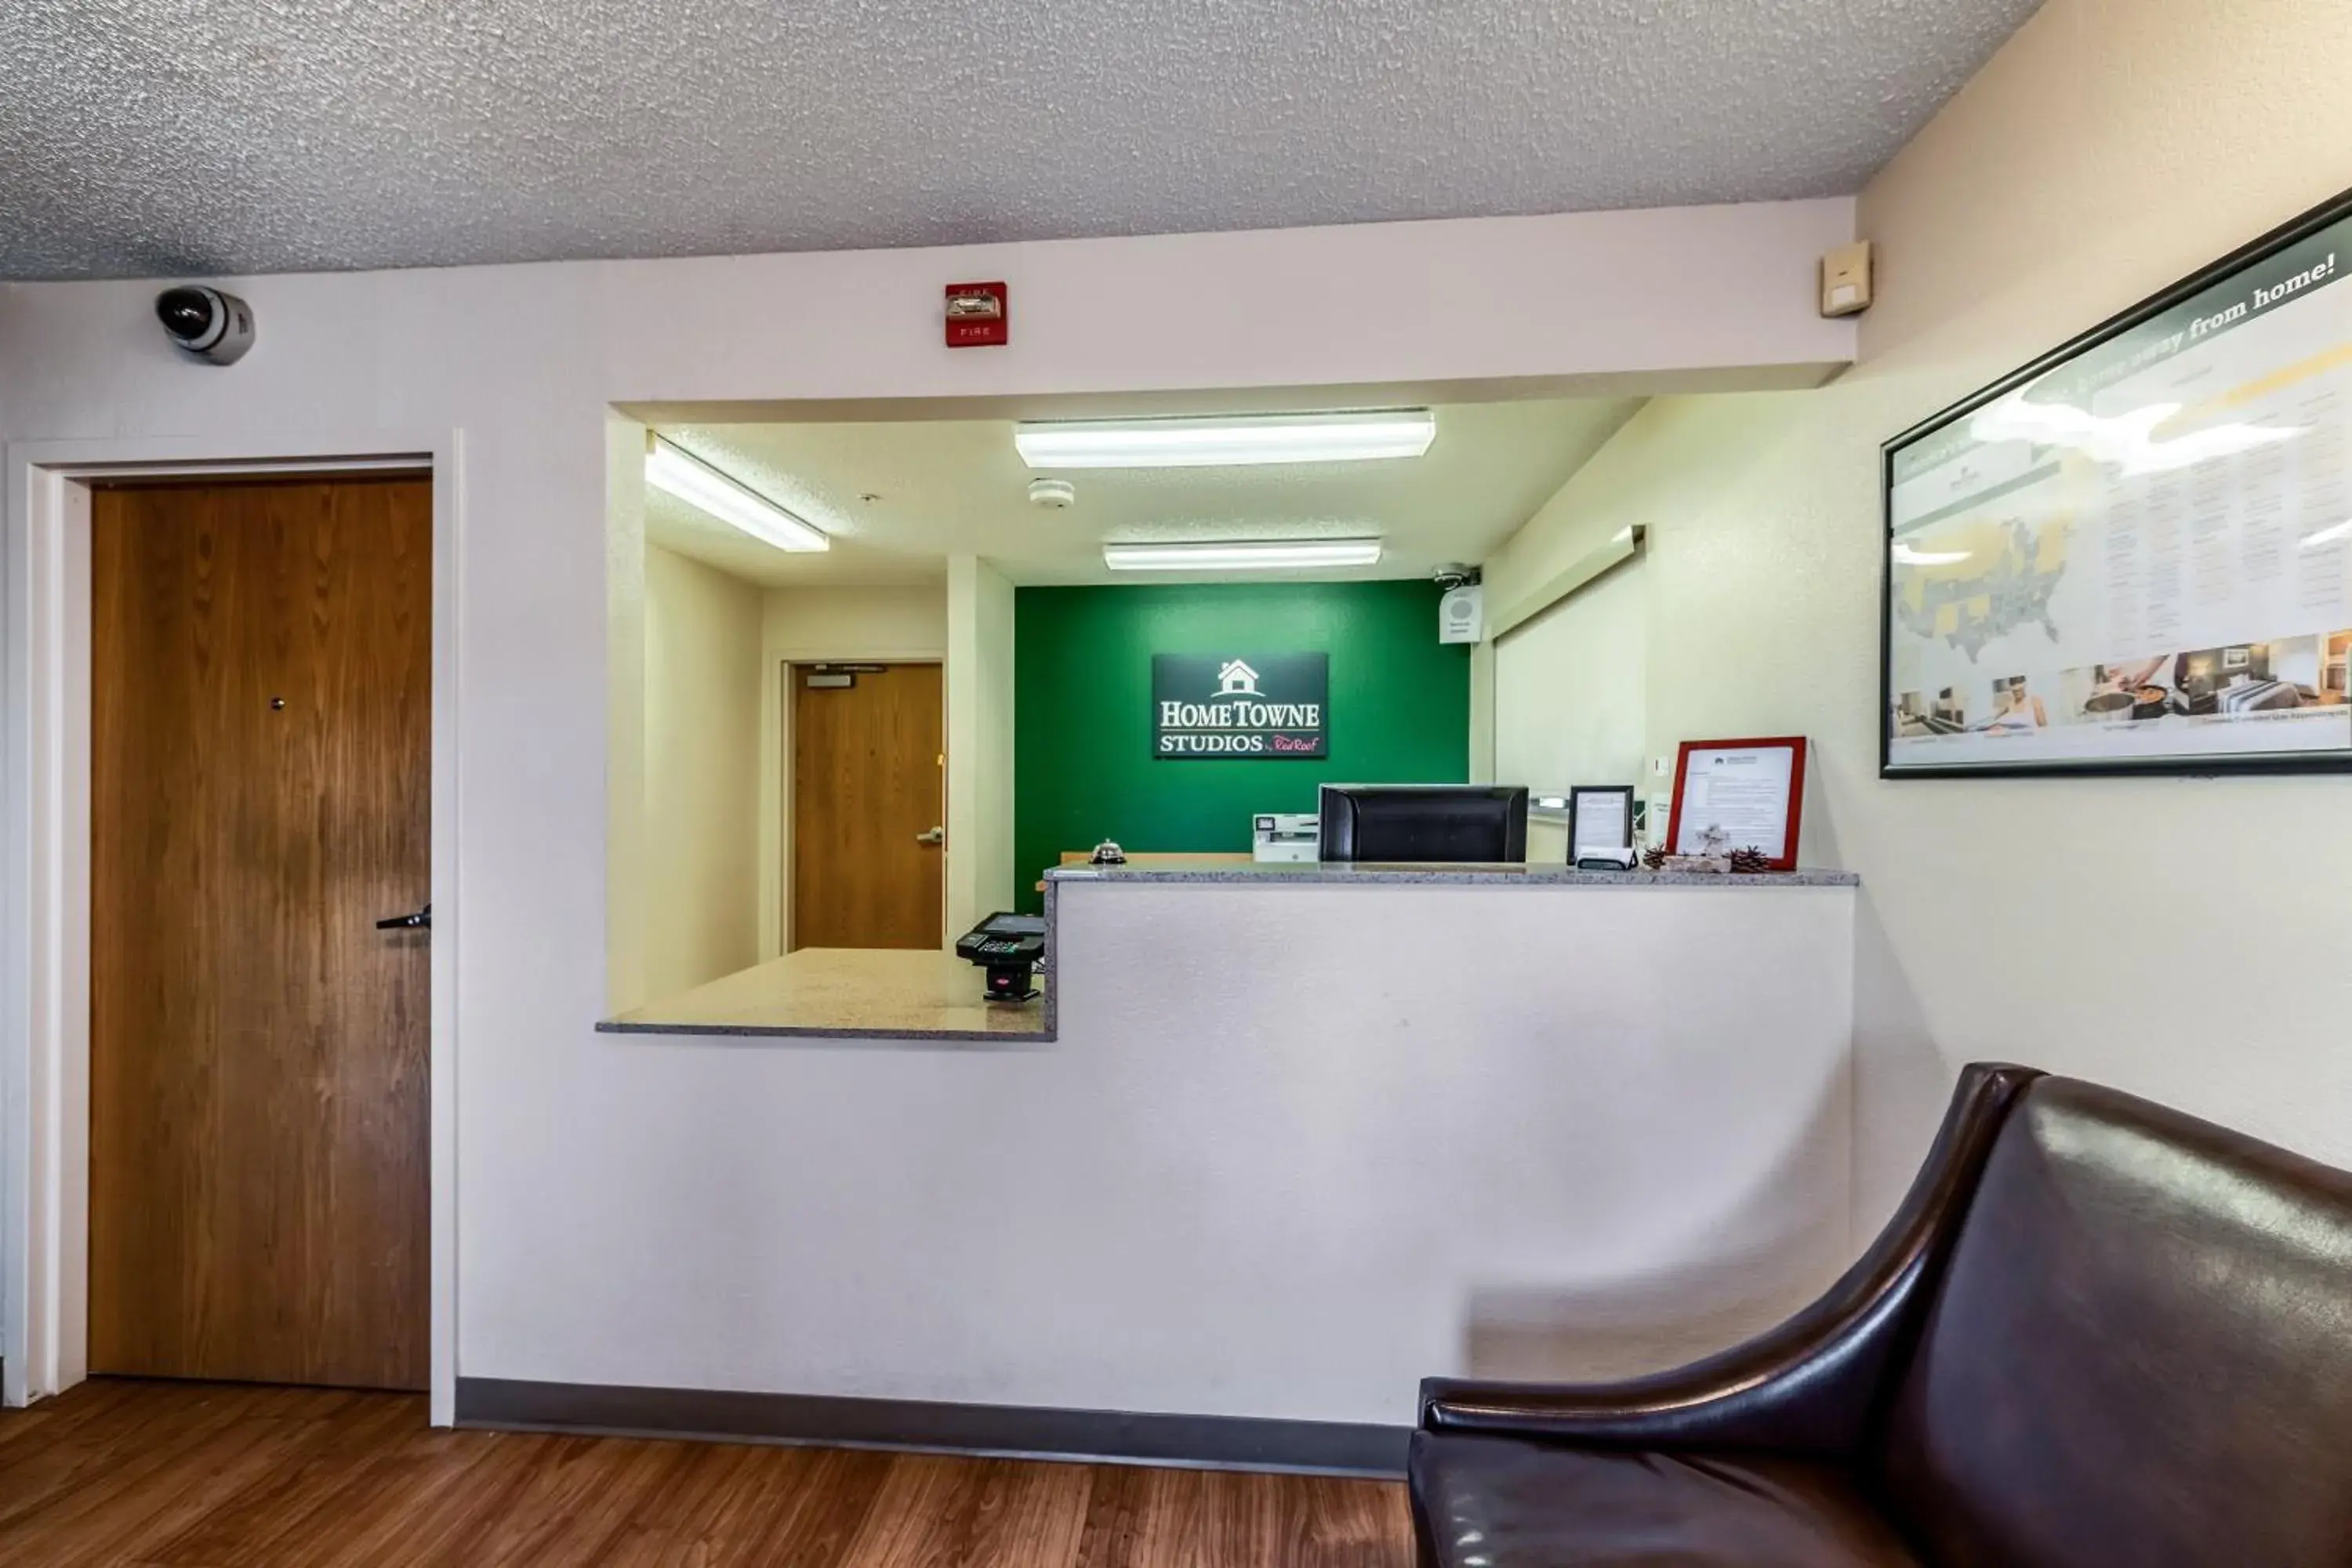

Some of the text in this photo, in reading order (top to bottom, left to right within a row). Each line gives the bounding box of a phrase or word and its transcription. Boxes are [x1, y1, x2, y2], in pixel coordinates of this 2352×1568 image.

[2132, 330, 2183, 366] away
[2189, 301, 2247, 340] from
[2252, 252, 2336, 310] home!
[960, 327, 990, 337] FIRE
[1160, 700, 1320, 728] HOMETOWNE
[1160, 735, 1264, 752] STUDIOS
